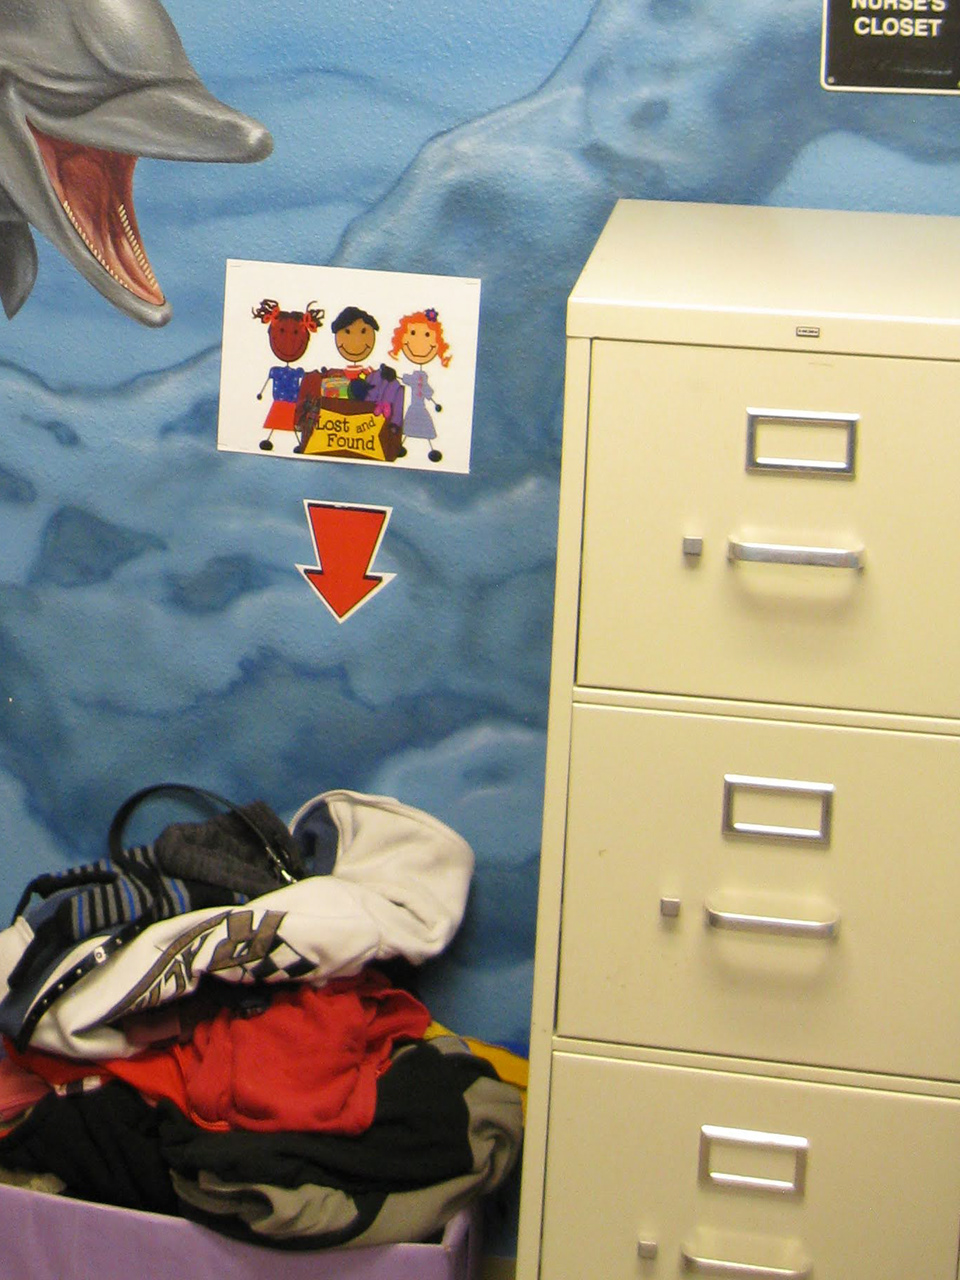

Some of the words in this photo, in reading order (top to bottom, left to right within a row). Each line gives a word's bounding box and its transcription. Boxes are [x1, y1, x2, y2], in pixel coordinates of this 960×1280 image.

[853, 16, 943, 37] CLOSET
[316, 416, 350, 433] Lost
[356, 416, 376, 433] and
[327, 433, 376, 451] Found
